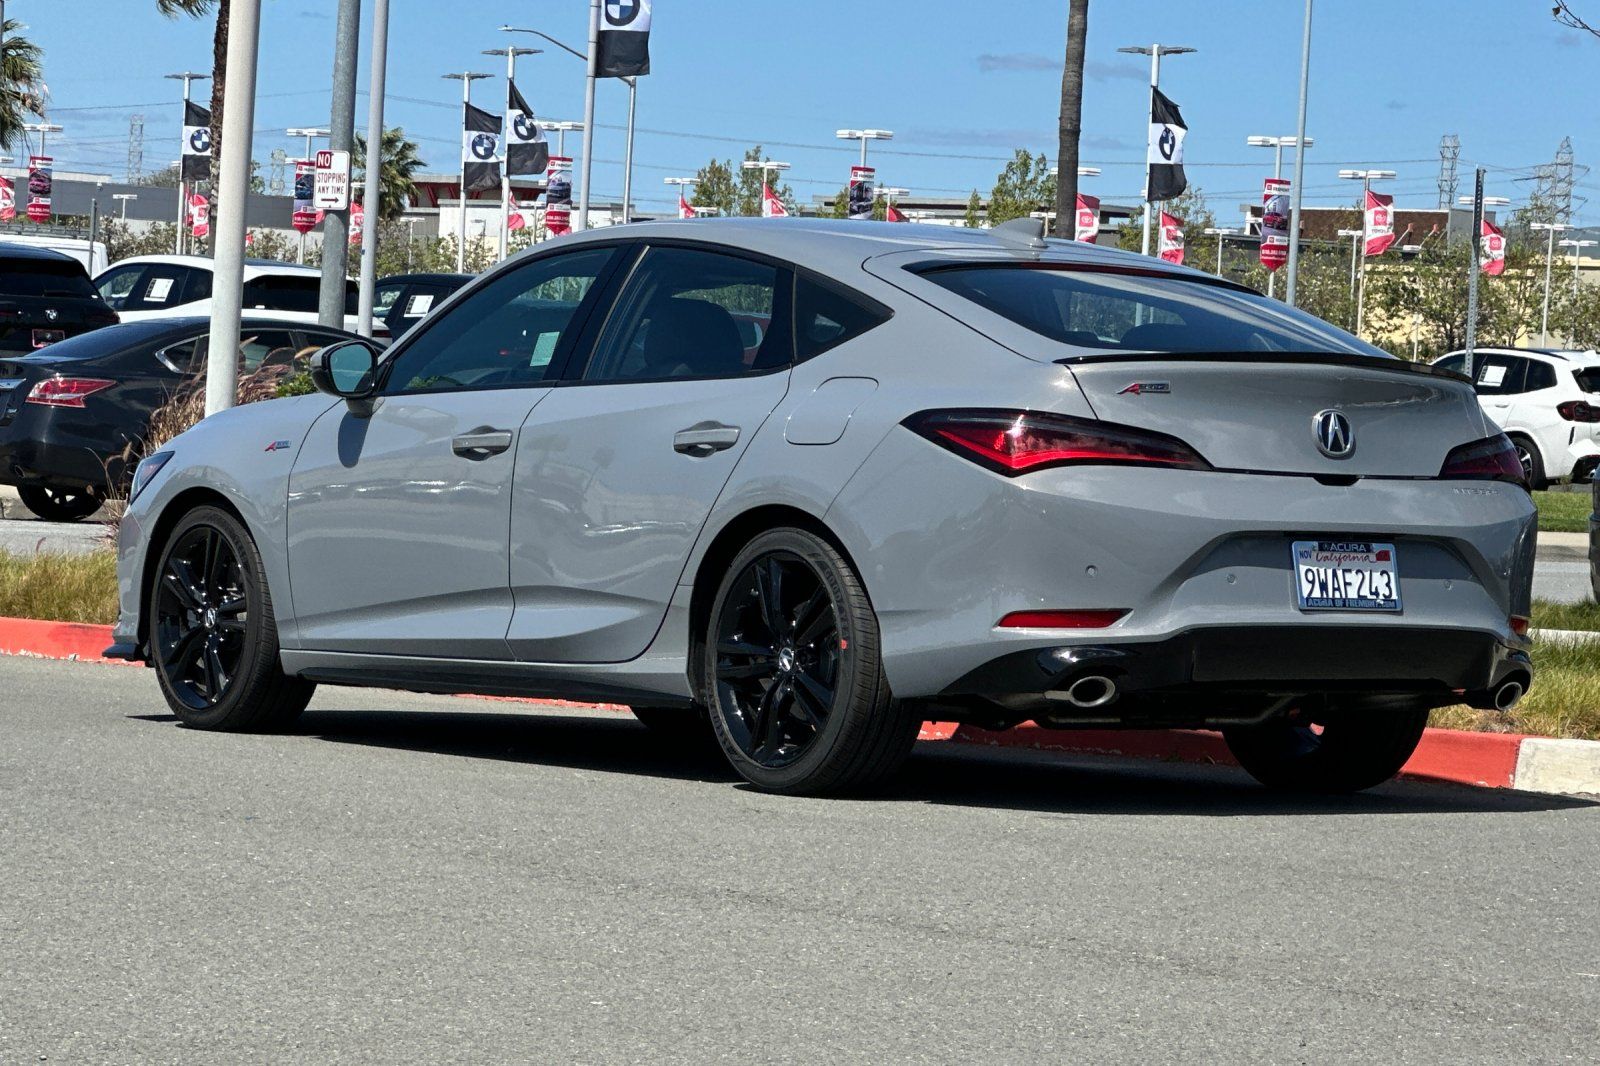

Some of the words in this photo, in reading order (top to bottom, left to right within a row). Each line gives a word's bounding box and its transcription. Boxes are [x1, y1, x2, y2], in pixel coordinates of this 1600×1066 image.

[318, 154, 330, 166] NO
[318, 172, 345, 183] STOPPING
[331, 186, 344, 194] TIME
[1330, 542, 1367, 552] ACURA
[1299, 550, 1312, 559] NOV
[1315, 551, 1376, 567] California
[1304, 567, 1393, 599] 9WAF243
